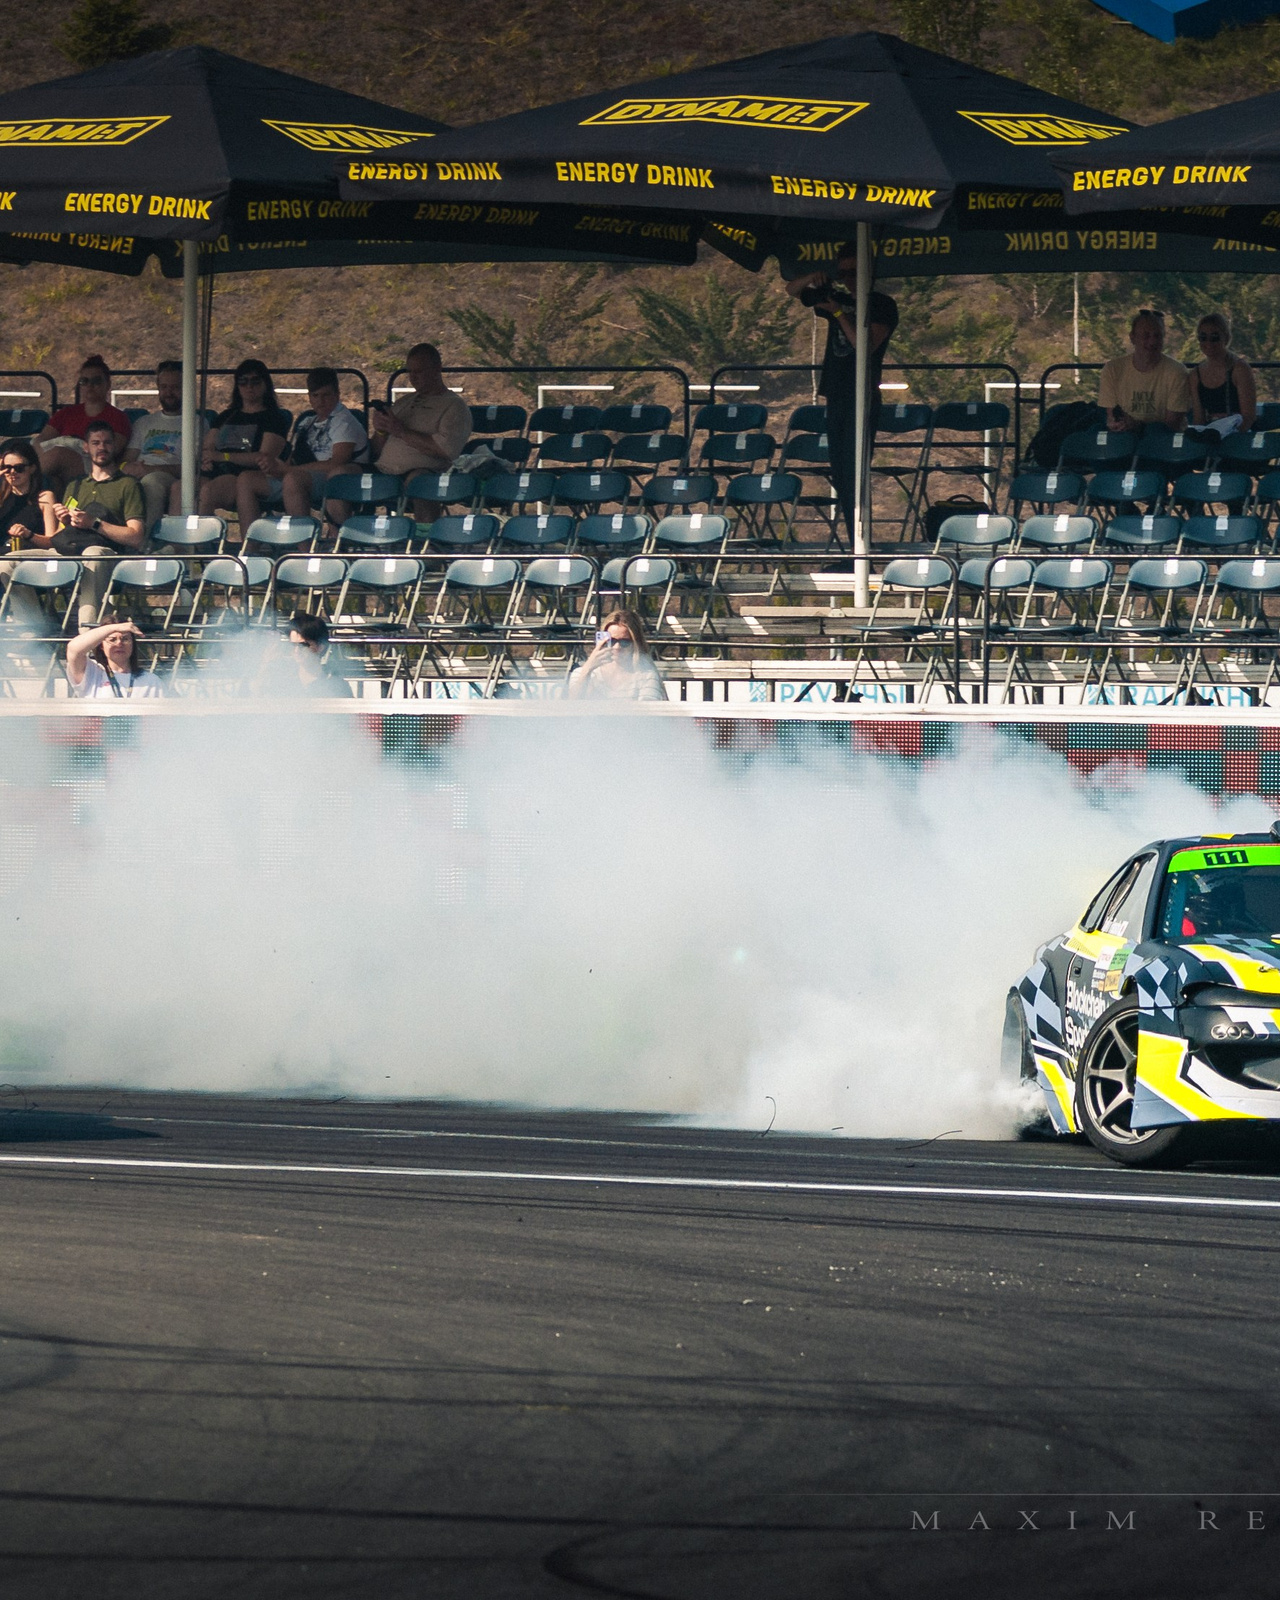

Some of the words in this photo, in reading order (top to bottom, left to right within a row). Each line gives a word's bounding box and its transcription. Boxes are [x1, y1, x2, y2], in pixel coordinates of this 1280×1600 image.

[348, 162, 428, 181] ENERGY
[436, 162, 502, 181] DRINK
[555, 161, 639, 183] ENERGY
[647, 164, 715, 189] DRINK
[1072, 166, 1166, 192] ENERGY
[1172, 165, 1252, 184] DRINK
[771, 175, 857, 200] ENERGY
[866, 184, 937, 209] DRINK
[64, 192, 143, 214] ENERGY
[148, 195, 212, 220] DRINK
[247, 200, 313, 221] ENERGY
[317, 199, 373, 218] DRINK
[414, 203, 482, 223] ENERGY
[485, 207, 540, 226] DRINK
[1207, 851, 1243, 865] 111
